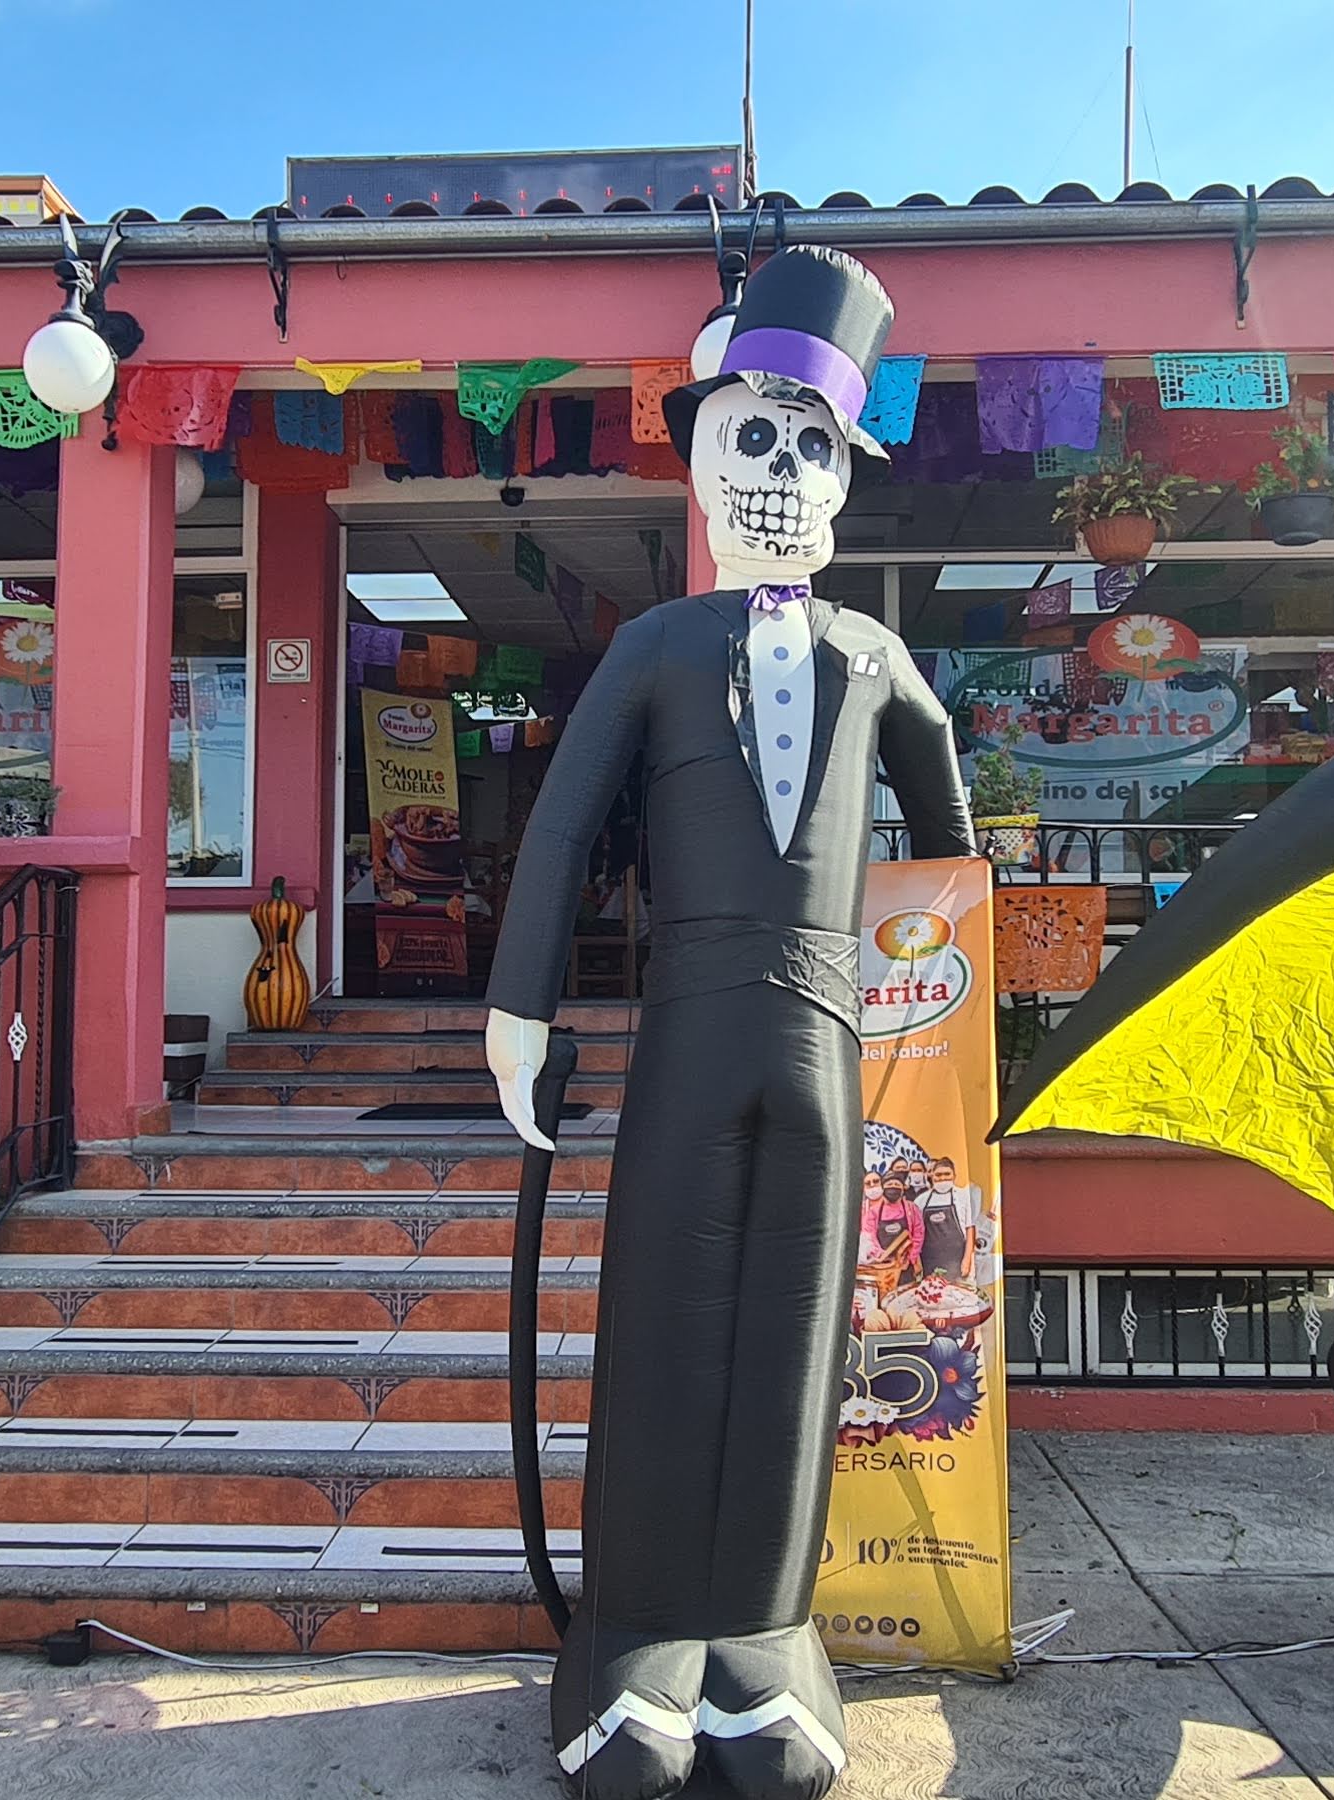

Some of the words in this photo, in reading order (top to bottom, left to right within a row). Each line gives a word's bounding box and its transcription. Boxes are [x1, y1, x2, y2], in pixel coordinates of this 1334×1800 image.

[970, 704, 1215, 743] Margarita
[393, 763, 435, 783] MOLE
[381, 774, 446, 795] CADERAS
[891, 1041, 949, 1060] sabor!
[857, 1536, 905, 1565] 10%
[907, 1535, 921, 1545] de
